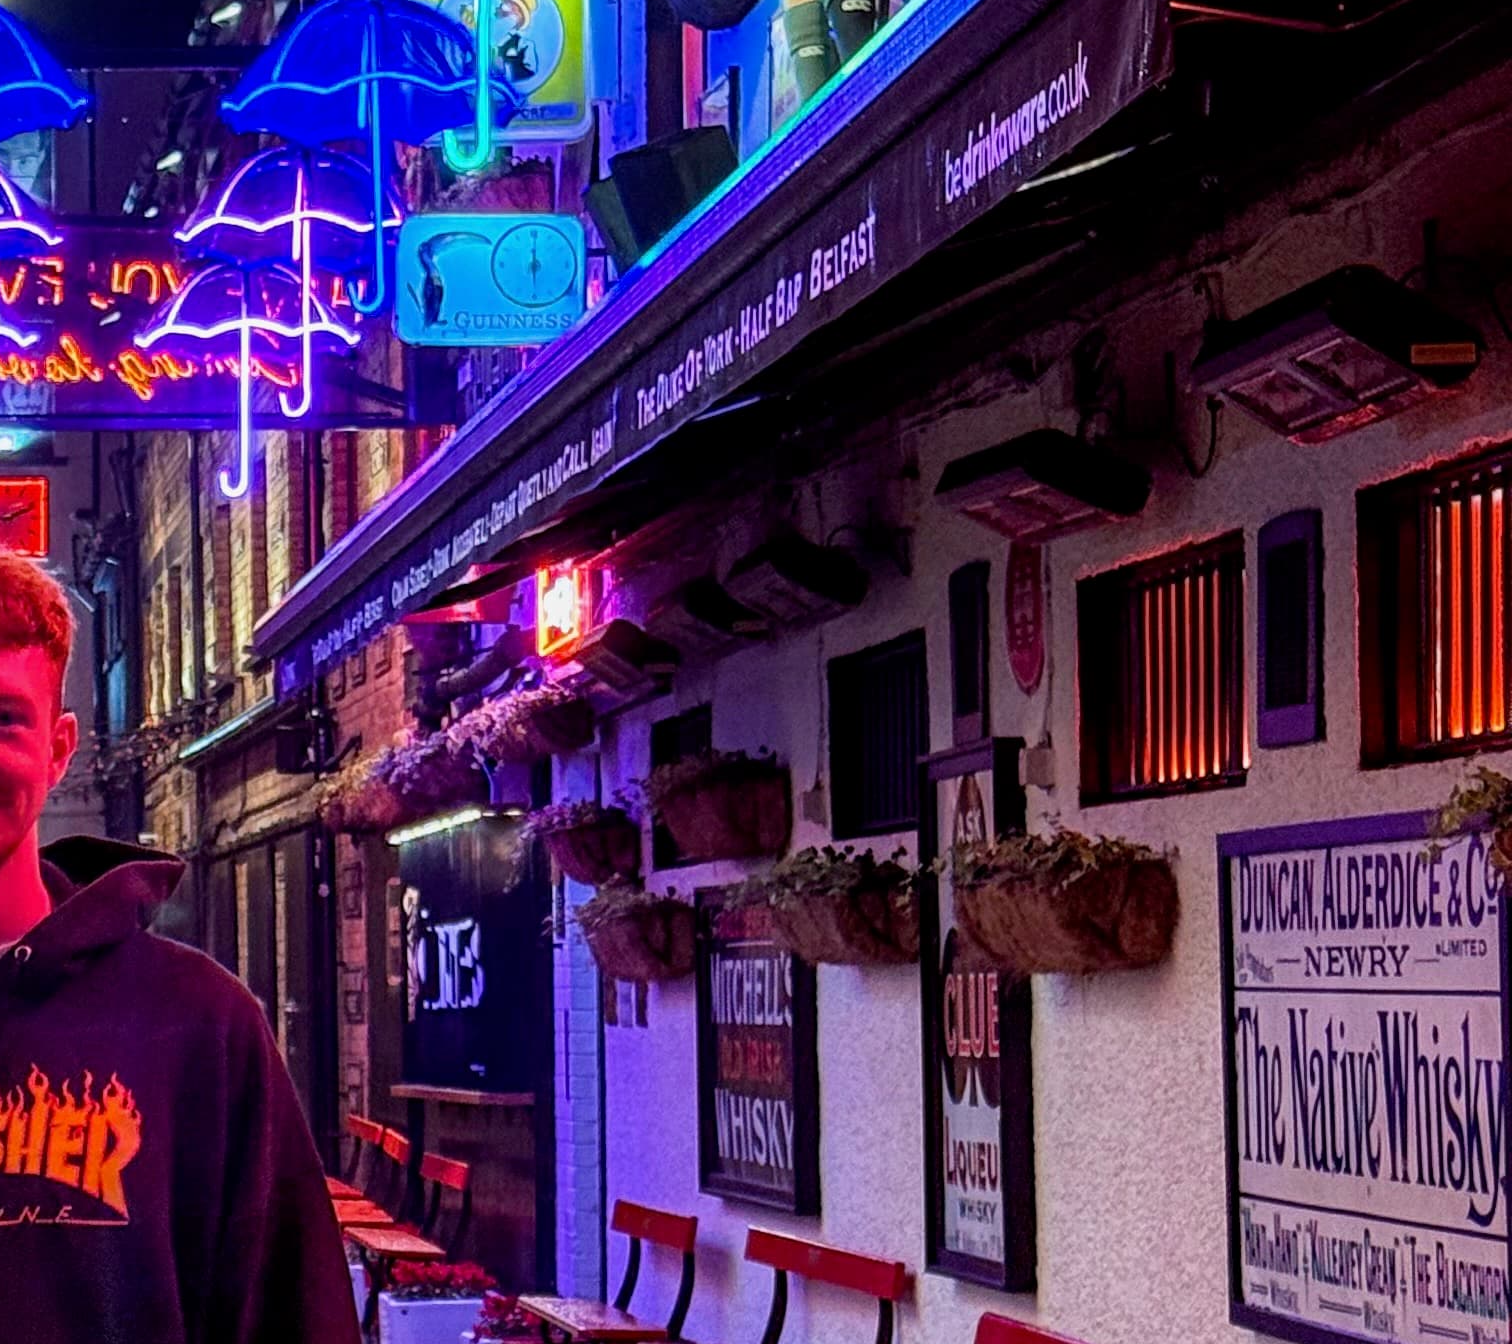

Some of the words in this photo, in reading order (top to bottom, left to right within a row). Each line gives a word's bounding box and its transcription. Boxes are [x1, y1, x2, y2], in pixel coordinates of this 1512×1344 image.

[944, 39, 1091, 205] bedrinkaware.co.uk
[454, 310, 573, 331] GUINNESS
[656, 372, 685, 416] DUKE
[684, 348, 703, 393] OF
[703, 325, 735, 378] YORK
[740, 294, 775, 355] HALF
[775, 270, 803, 329] BAP
[809, 215, 877, 301] BELFAST
[563, 444, 588, 483] CALL
[591, 420, 614, 467] AGAIN
[1321, 847, 1444, 931] ALDERDICE
[1447, 859, 1473, 928] &
[1303, 944, 1411, 978] NEWRY
[714, 1087, 793, 1170] WHISKY
[1238, 1006, 1286, 1165] The
[1287, 1007, 1382, 1179] Native
[1377, 1010, 1502, 1229] Whisky
